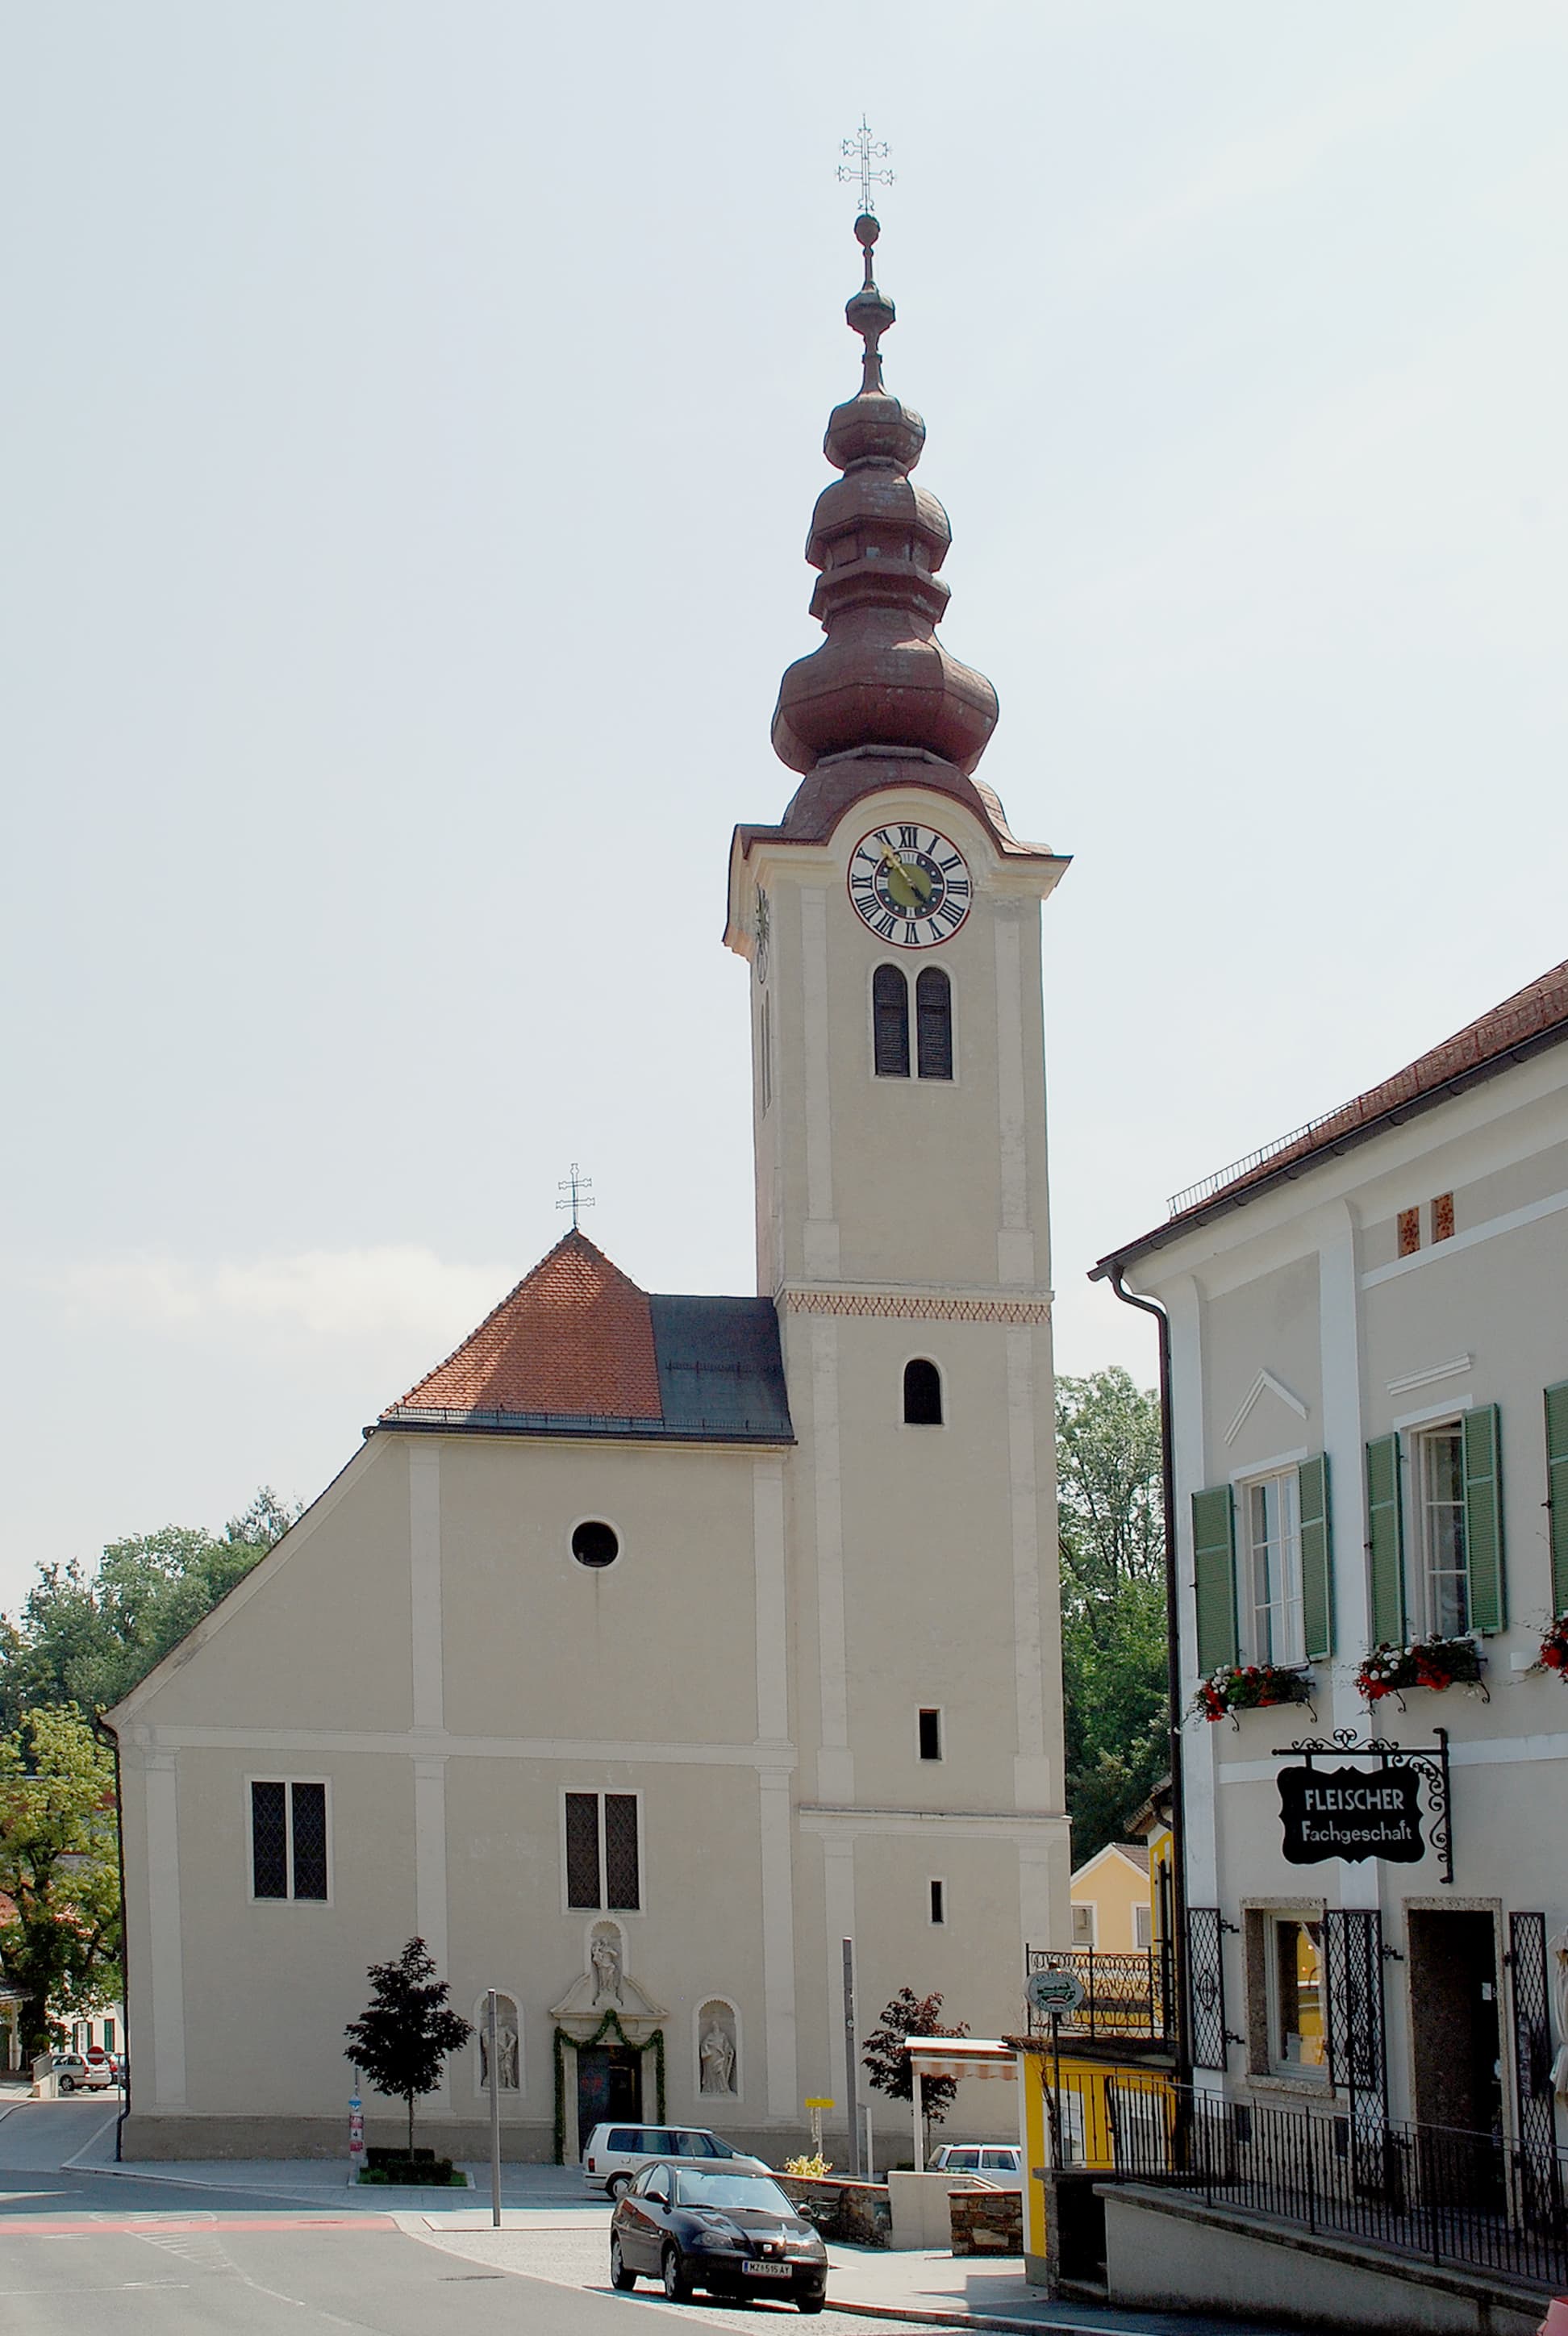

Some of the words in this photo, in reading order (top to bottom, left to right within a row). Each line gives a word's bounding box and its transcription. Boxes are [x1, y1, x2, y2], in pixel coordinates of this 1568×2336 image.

[898, 826, 919, 849] XII
[925, 835, 940, 855] I
[856, 847, 879, 869] X
[938, 854, 962, 873] II
[852, 874, 873, 889] IX
[946, 879, 969, 897] III
[855, 893, 882, 923] VIII
[873, 912, 899, 940] VII
[903, 921, 920, 944] VI
[927, 918, 945, 941] V
[1304, 1788, 1404, 1811] FLEISCHER
